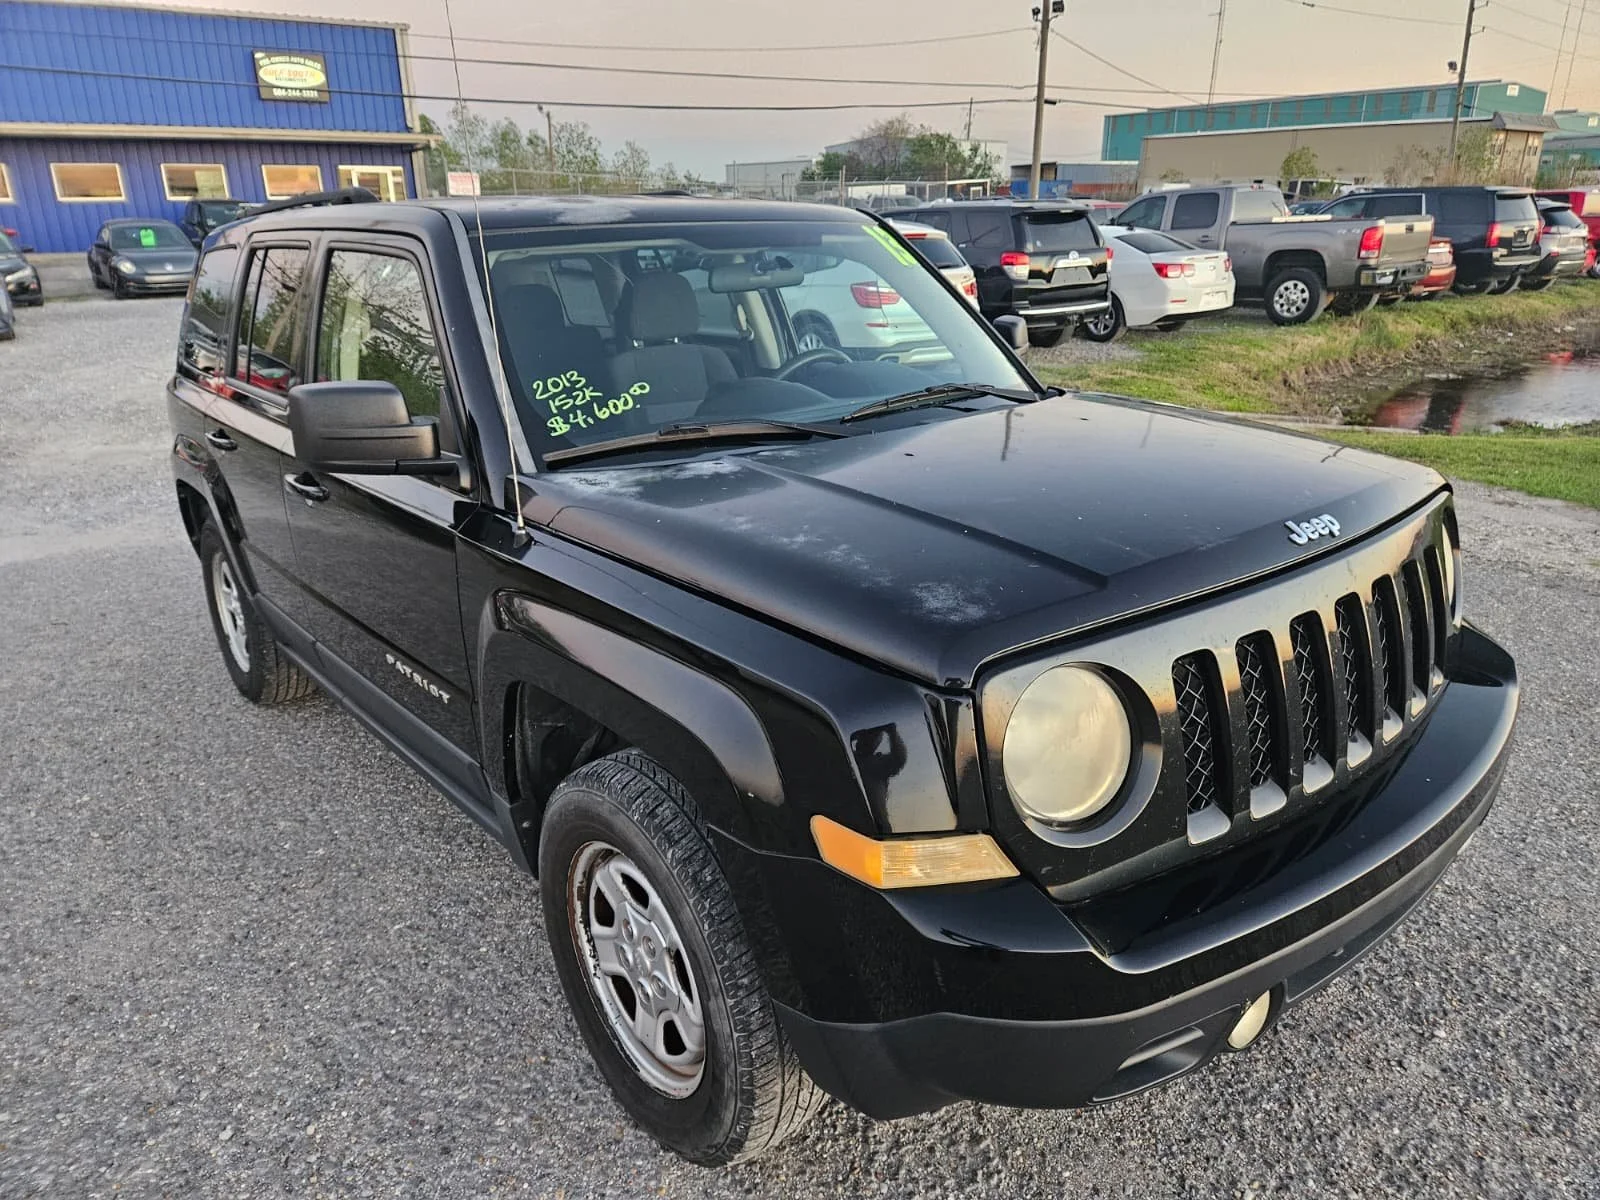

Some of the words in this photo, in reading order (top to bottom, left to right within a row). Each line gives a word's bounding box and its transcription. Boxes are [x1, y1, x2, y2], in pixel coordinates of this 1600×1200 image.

[532, 370, 587, 400] 2013
[548, 386, 604, 415] 152K
[1283, 513, 1341, 546] Jeep
[385, 653, 451, 705] PATRIOT
